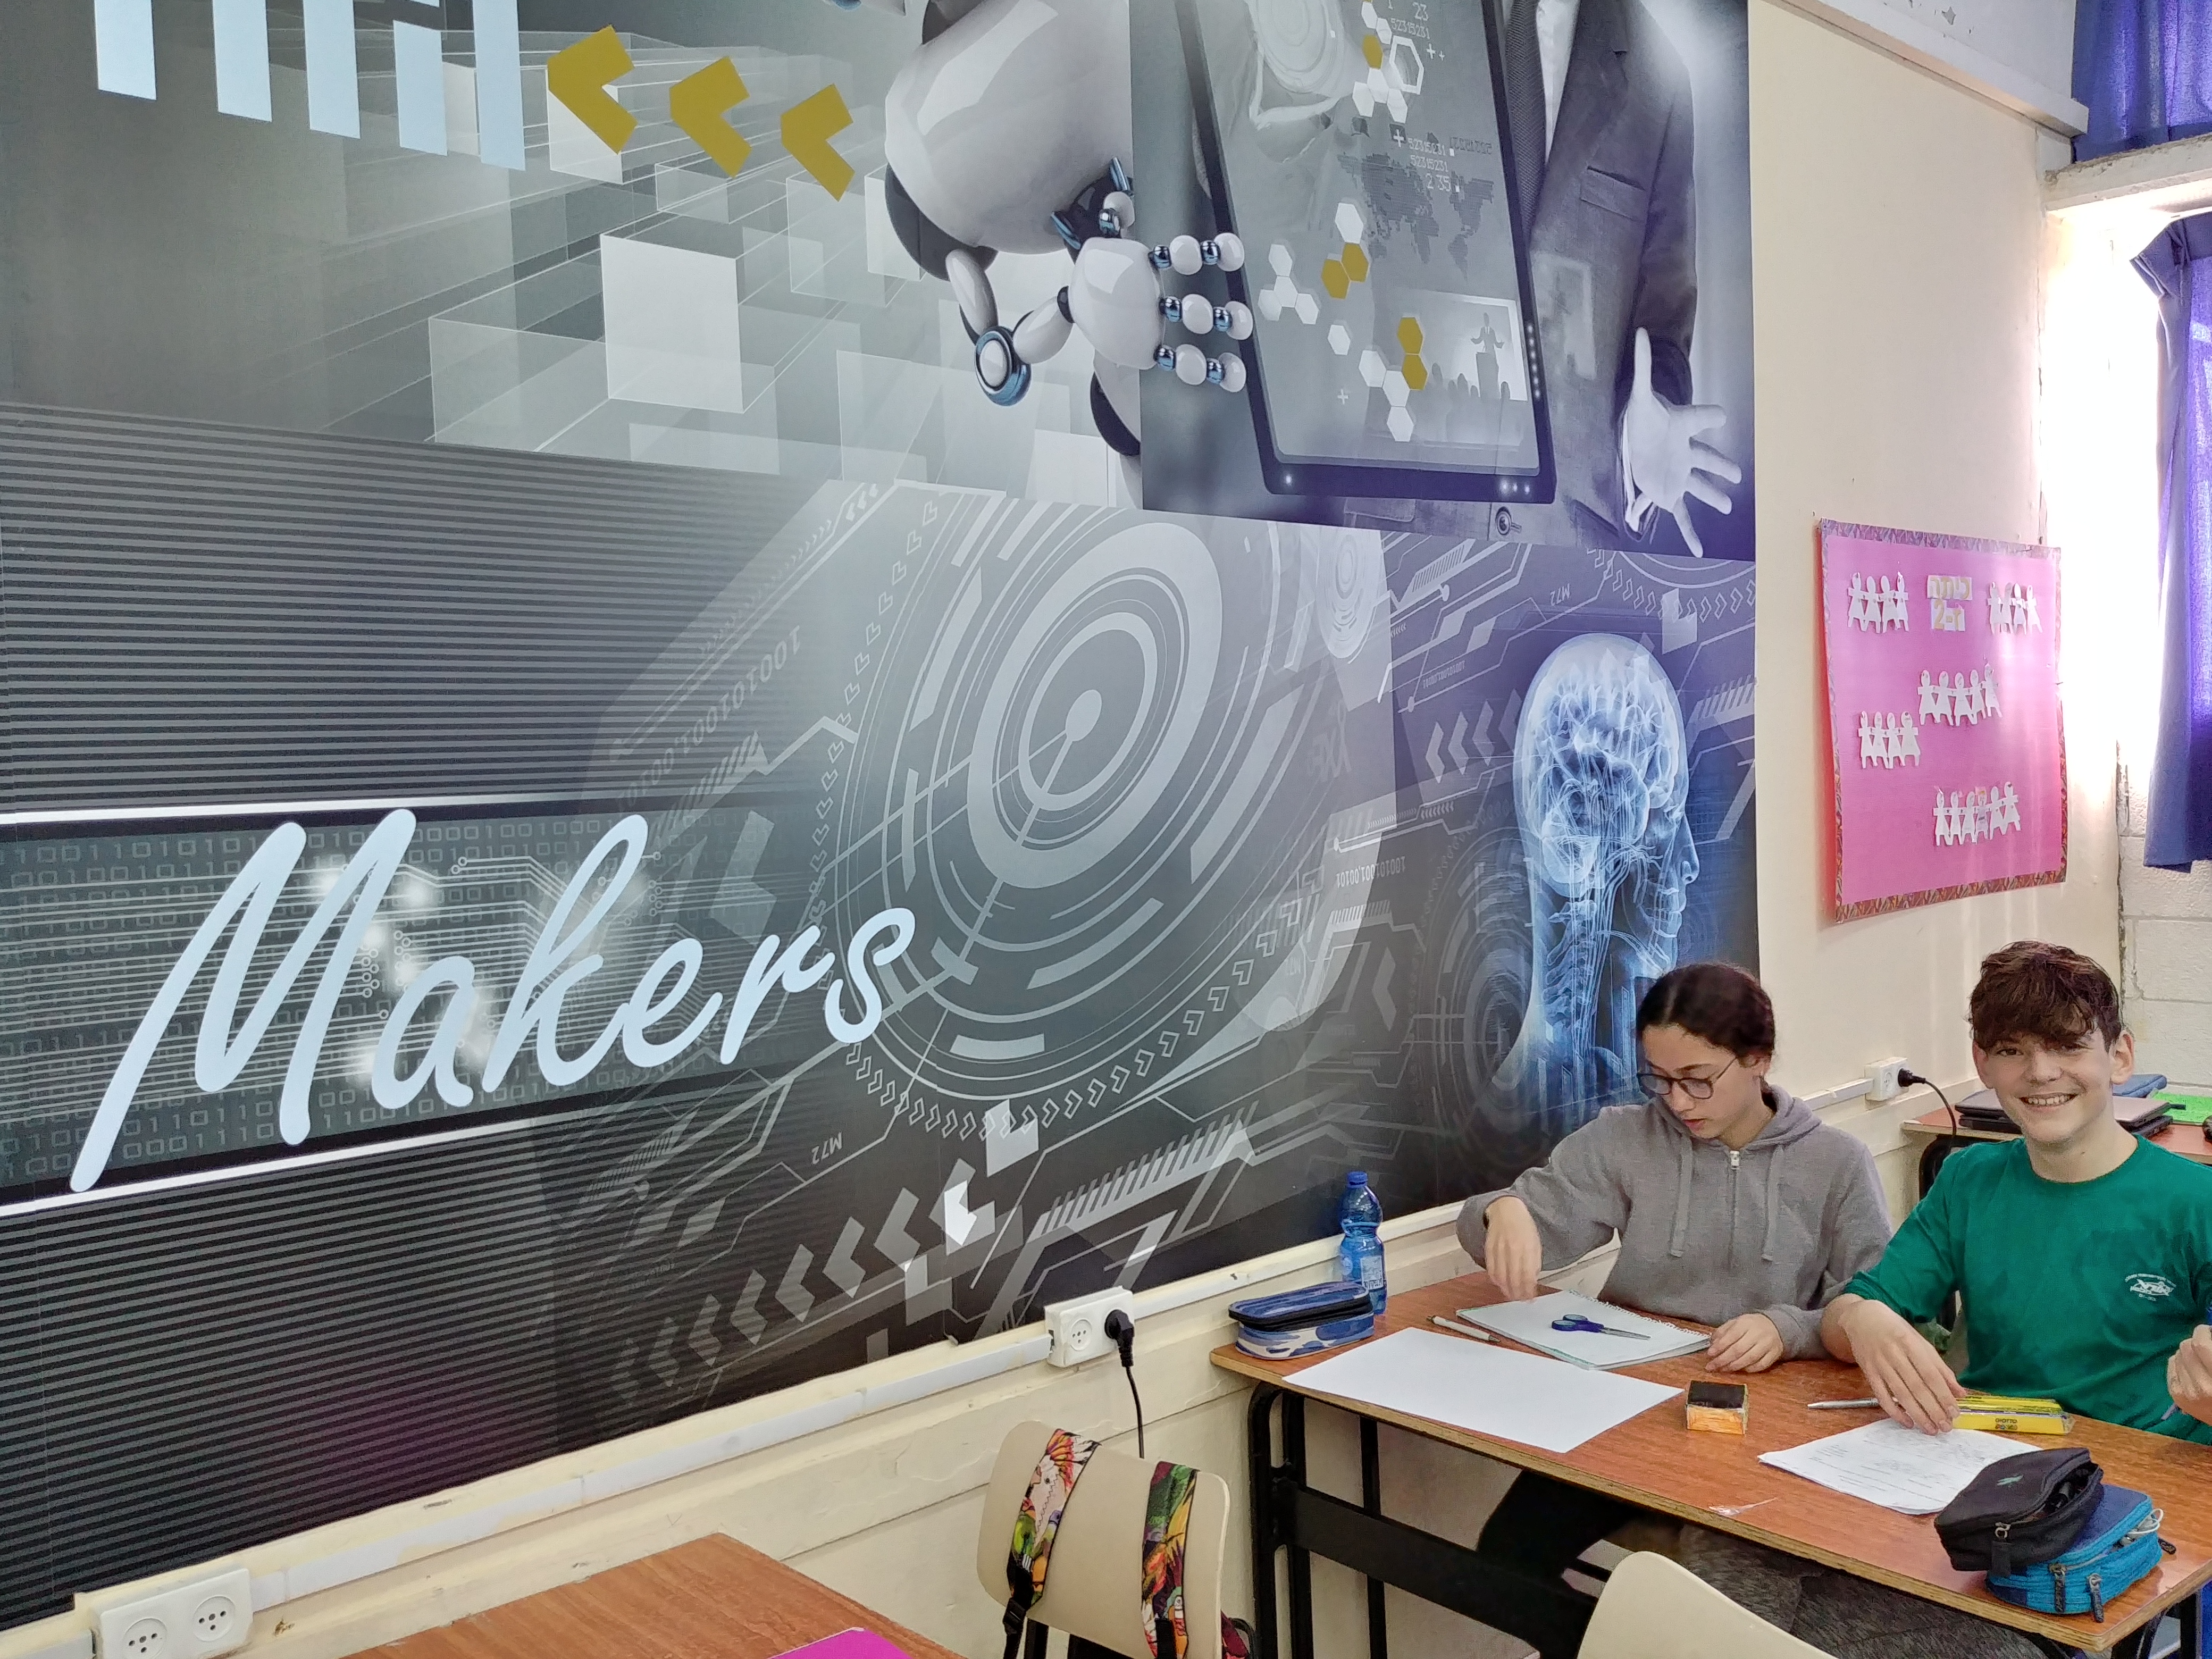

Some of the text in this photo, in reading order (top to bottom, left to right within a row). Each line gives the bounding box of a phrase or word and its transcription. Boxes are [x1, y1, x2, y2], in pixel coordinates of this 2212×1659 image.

[1929, 576, 1970, 599] כיתה
[70, 809, 916, 1192] Makers
[811, 1131, 842, 1165] M72
